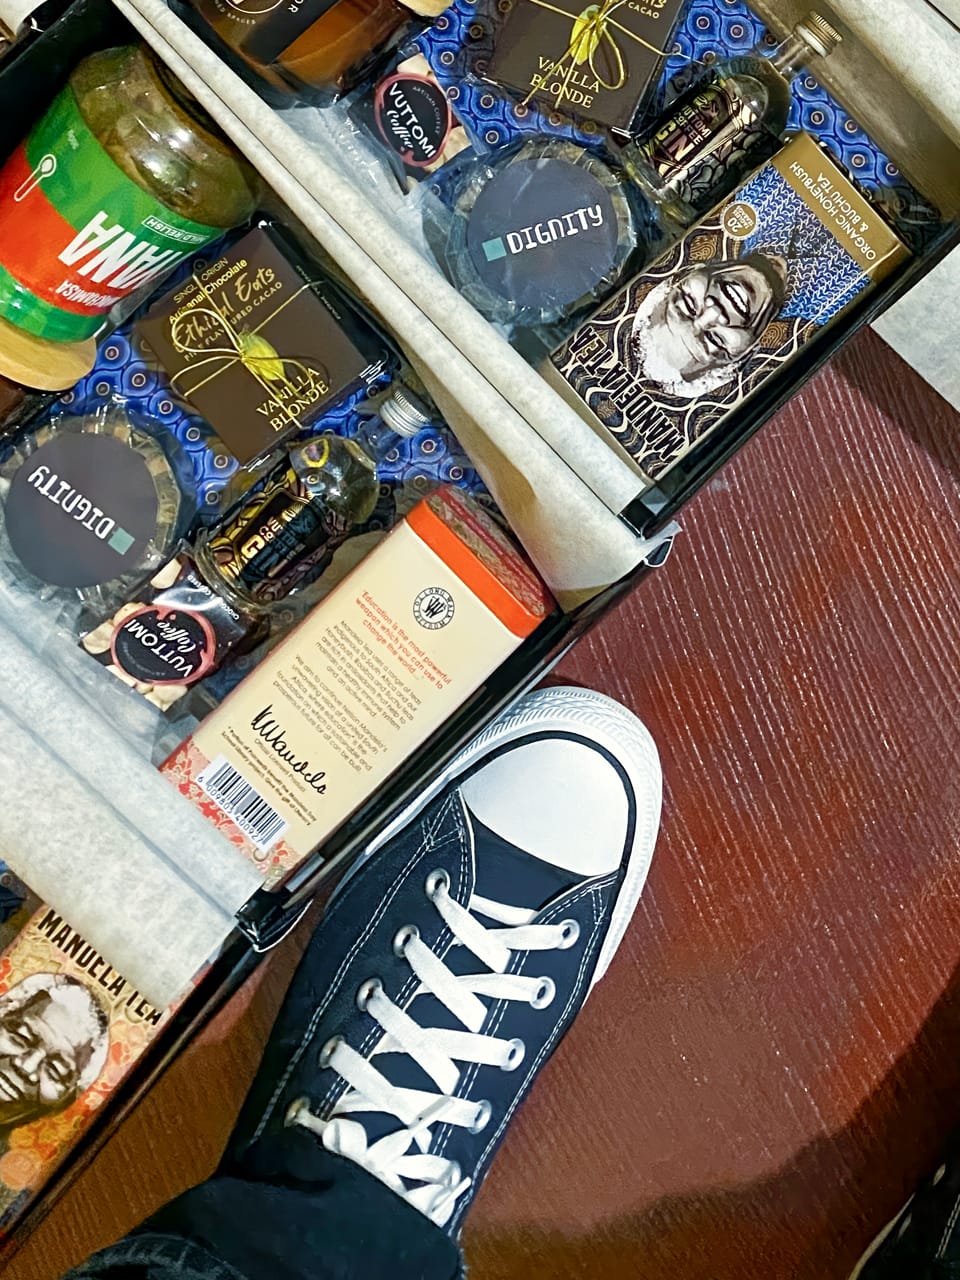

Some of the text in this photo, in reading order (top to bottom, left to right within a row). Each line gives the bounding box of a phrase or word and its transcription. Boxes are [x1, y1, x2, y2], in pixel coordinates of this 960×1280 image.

[628, 0, 660, 20] CACAO
[529, 73, 595, 109] BLONDE
[386, 109, 414, 150] Coffee
[387, 82, 436, 158] VUTTOMI
[789, 161, 877, 262] ORGANIC HONEYBUSH
[818, 172, 870, 237] & BUCHU TEA
[506, 201, 605, 256] DIGNITY
[205, 259, 248, 295] Chocolate
[236, 266, 276, 302] Eats
[254, 281, 283, 308] CACAO
[568, 326, 686, 461] MANDELA TEA
[27, 465, 116, 541] DIGNITY
[124, 619, 194, 677] VUTTOMI
[156, 621, 197, 655] Coffee
[352, 597, 444, 690] weapon which you can use to
[360, 618, 388, 646] change
[385, 642, 399, 656] the
[396, 628, 410, 642] the
[406, 639, 425, 658] most
[421, 655, 452, 686] powerful
[394, 689, 409, 703] and
[232, 814, 264, 845] 400927
